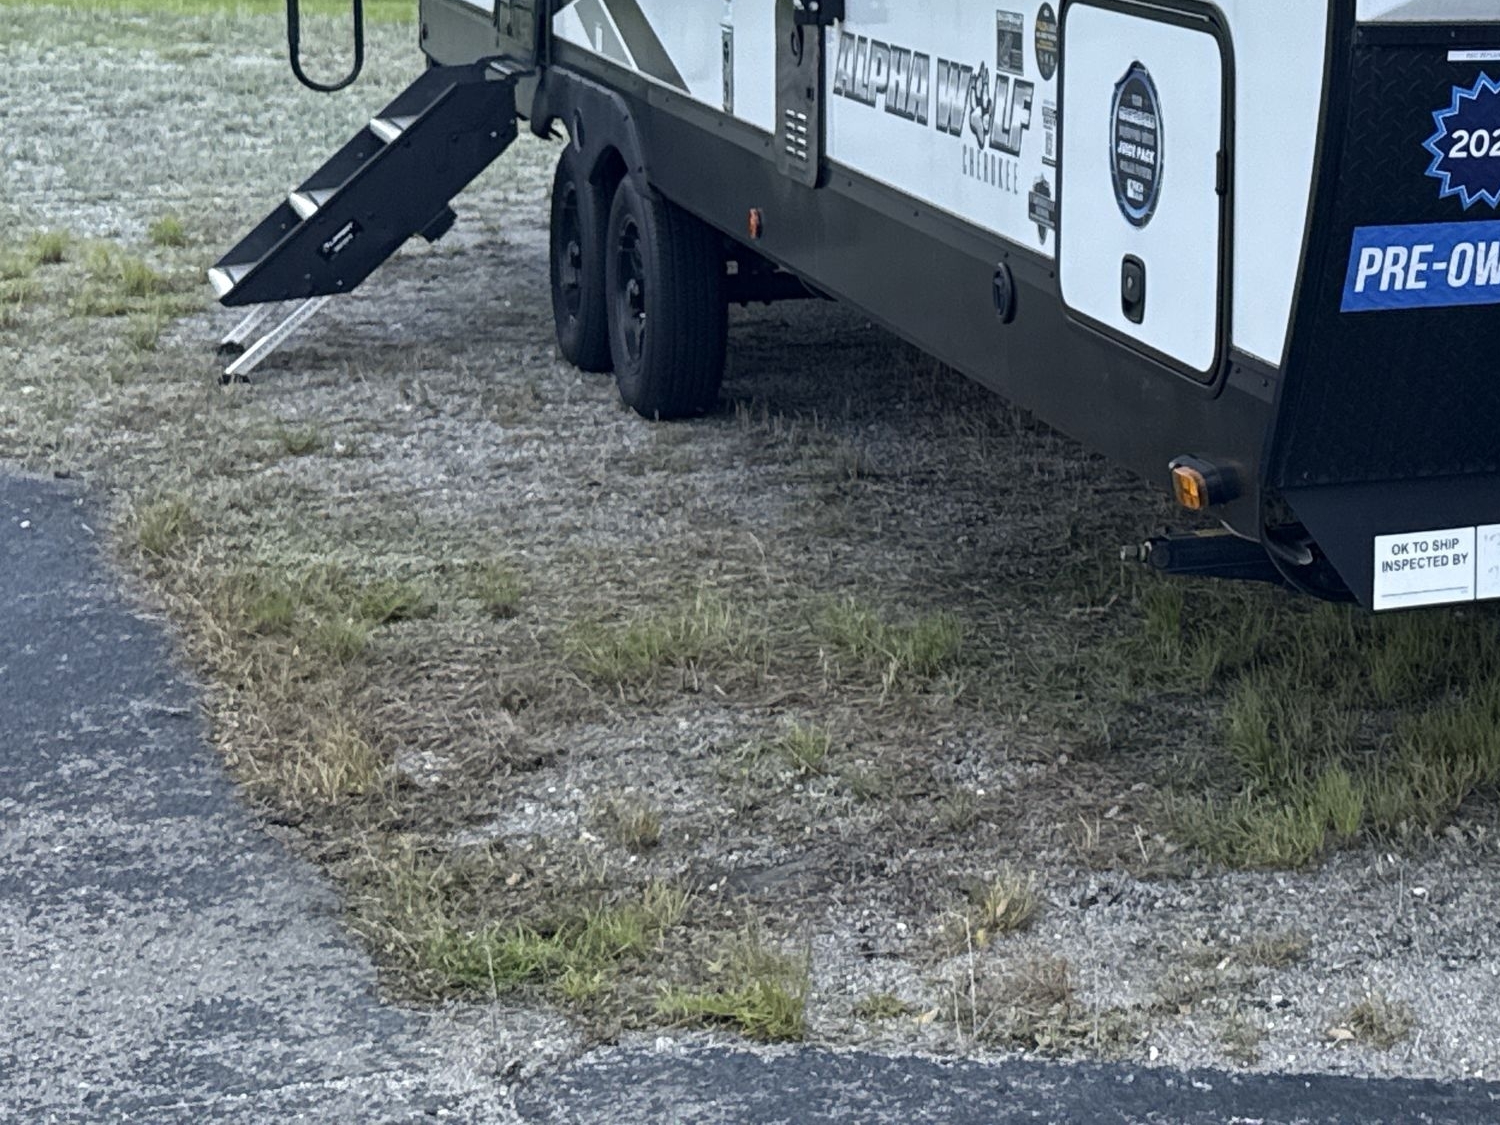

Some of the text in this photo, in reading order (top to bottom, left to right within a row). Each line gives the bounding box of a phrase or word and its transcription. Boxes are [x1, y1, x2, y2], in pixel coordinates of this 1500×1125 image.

[833, 30, 930, 127] ALPHA
[962, 143, 1018, 195] CHEROKEE
[1382, 552, 1469, 573] INSPECTED BY
[1391, 538, 1459, 555] OK TO SHIP
